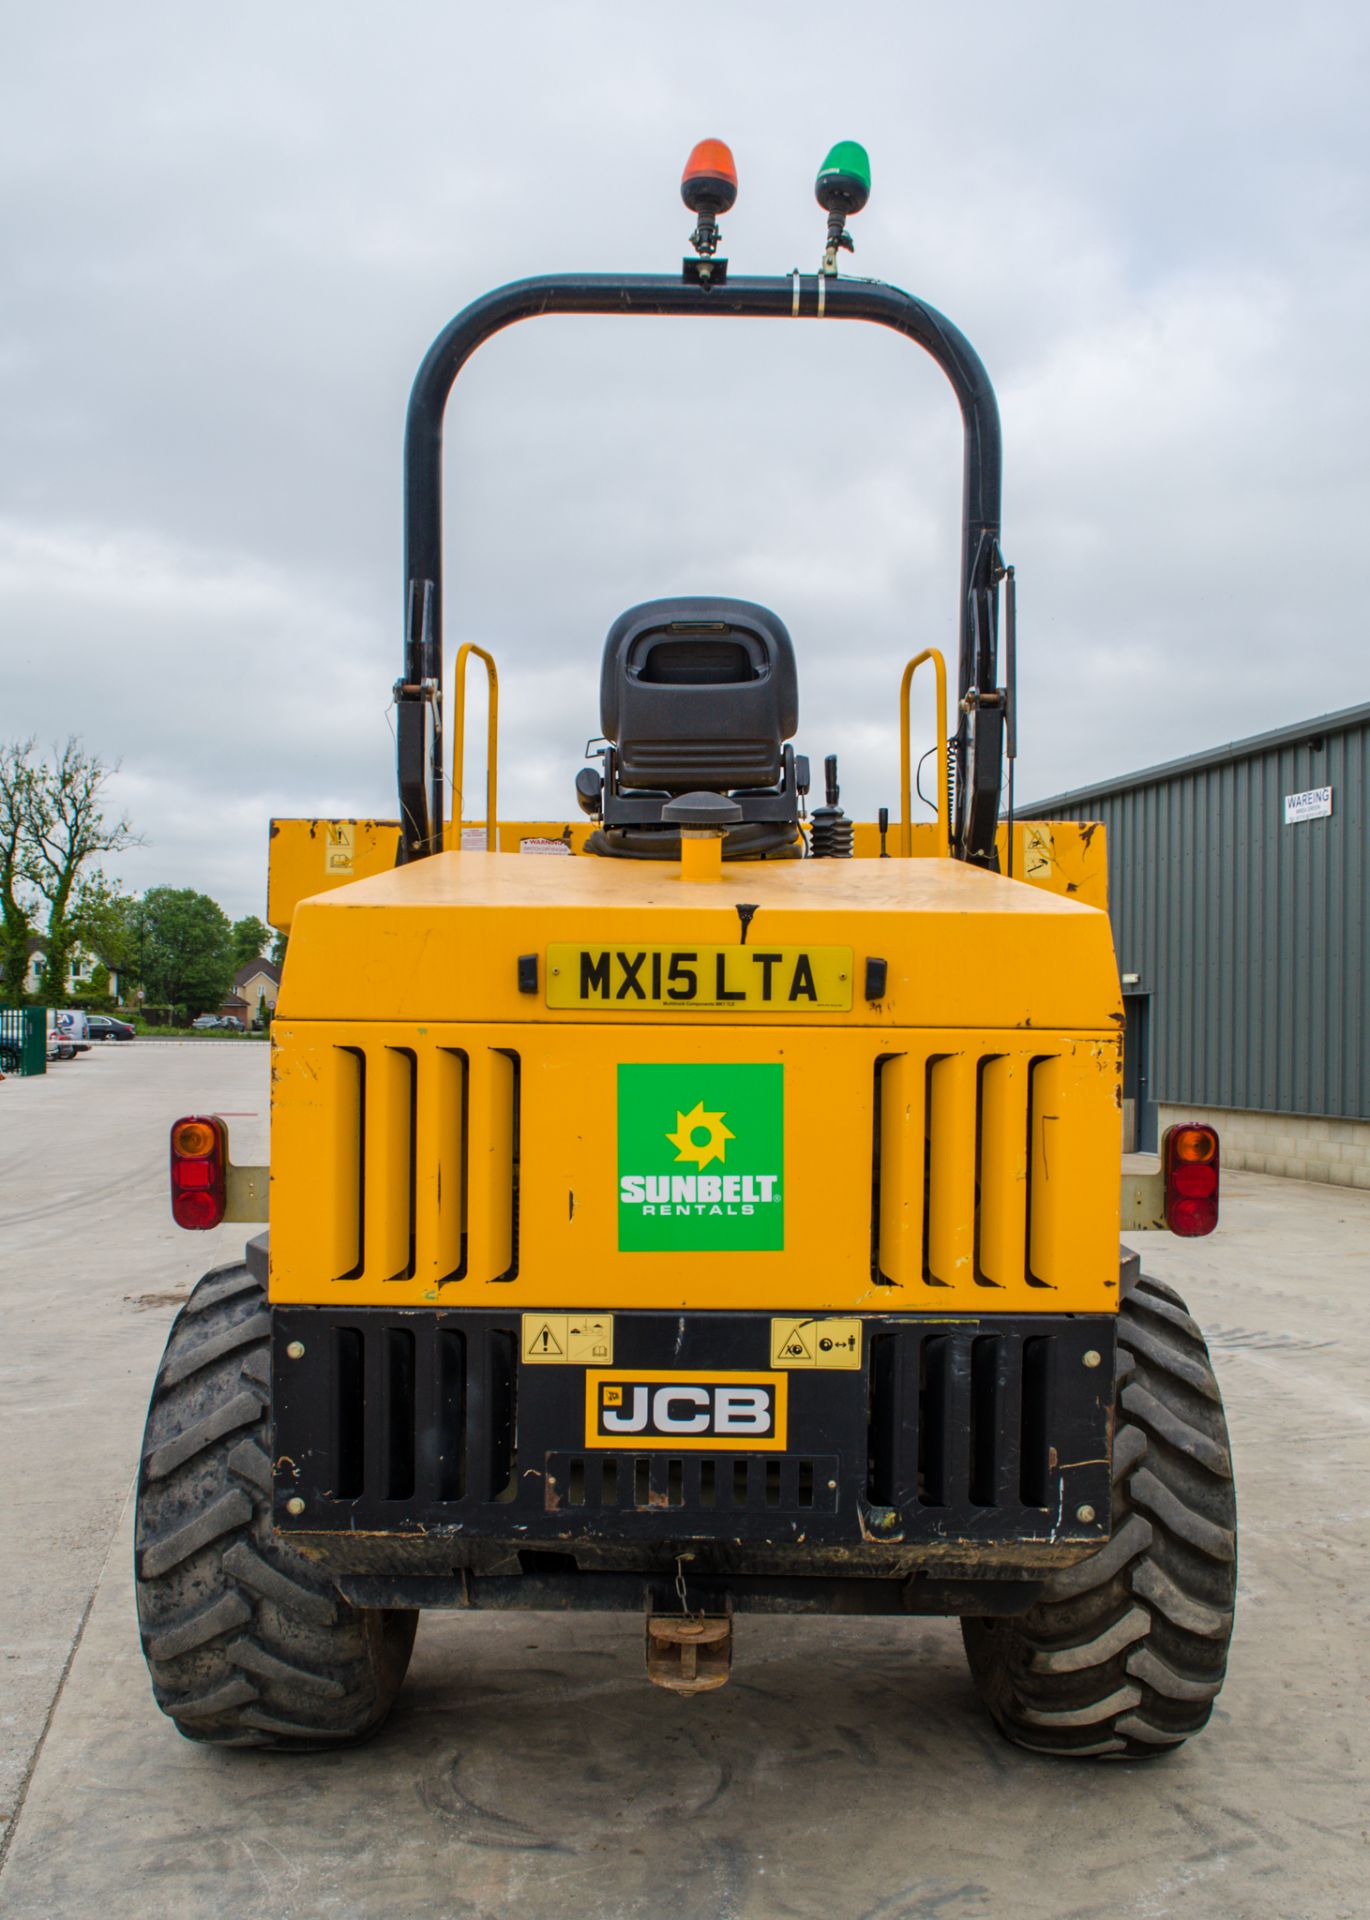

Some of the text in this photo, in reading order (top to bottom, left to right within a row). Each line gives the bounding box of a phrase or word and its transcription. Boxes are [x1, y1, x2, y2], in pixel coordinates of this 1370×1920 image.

[1287, 790, 1329, 808] WAREING
[580, 952, 818, 1001] MX15 LTA
[620, 1175, 777, 1203] SUNBELT
[642, 1205, 755, 1215] RENTALS
[602, 1387, 771, 1433] JCB
